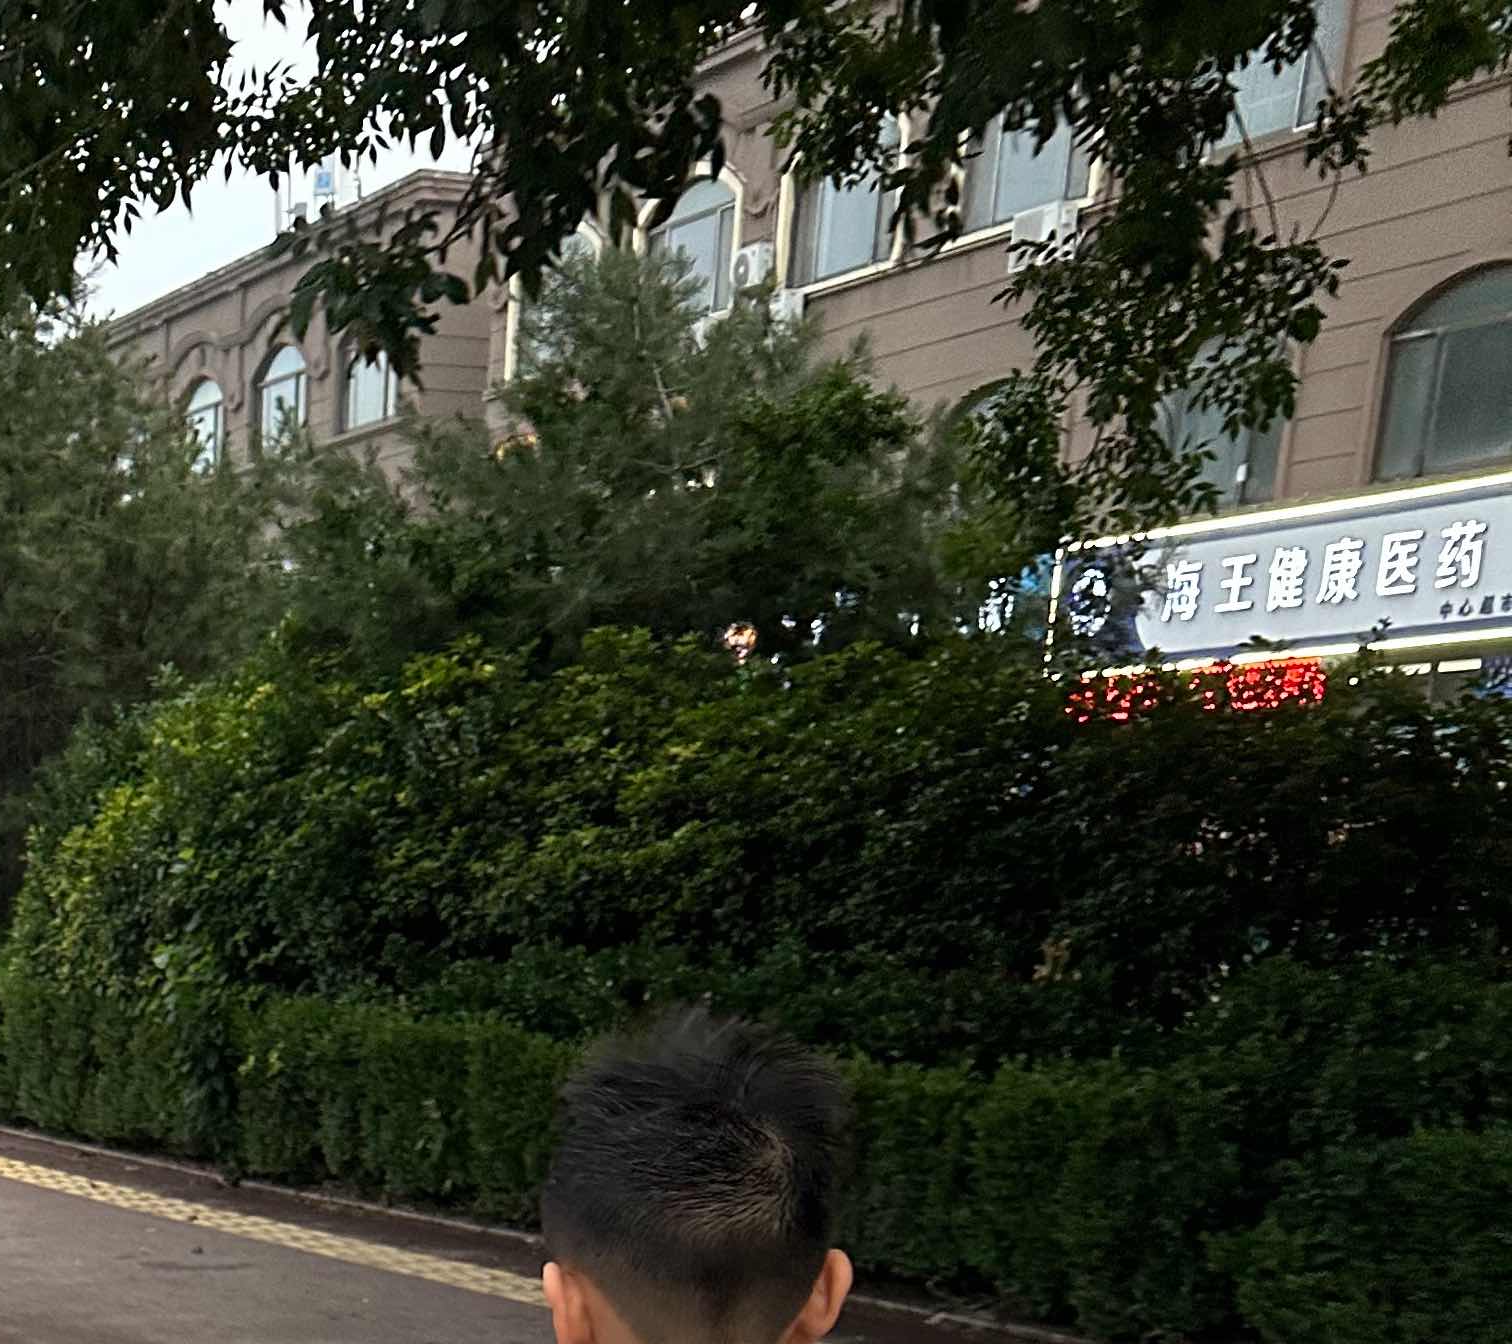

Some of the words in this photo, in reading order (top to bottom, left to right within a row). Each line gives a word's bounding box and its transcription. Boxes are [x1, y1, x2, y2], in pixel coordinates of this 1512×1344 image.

[1160, 519, 1488, 623] 海王健康医药
